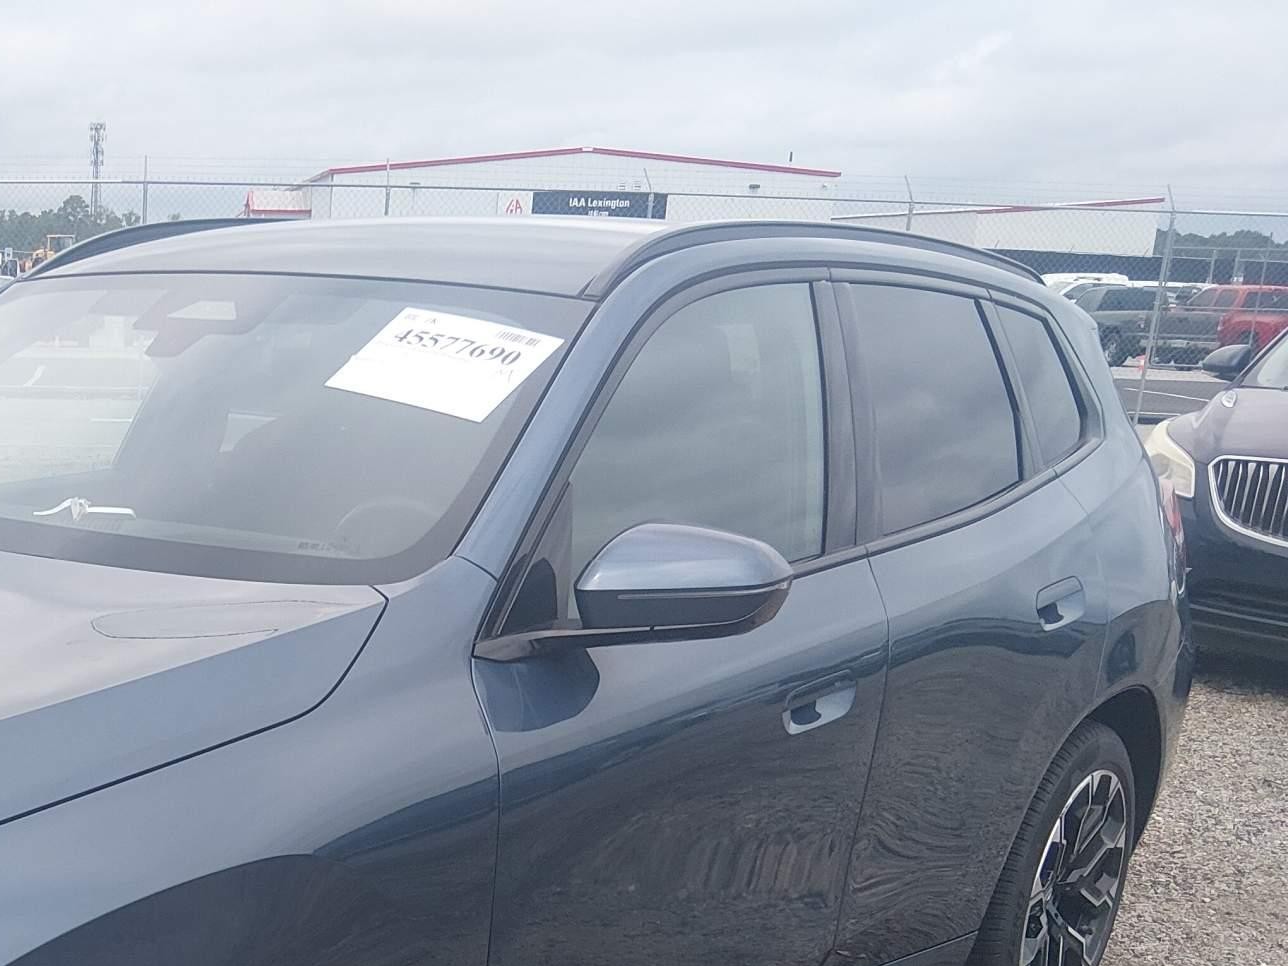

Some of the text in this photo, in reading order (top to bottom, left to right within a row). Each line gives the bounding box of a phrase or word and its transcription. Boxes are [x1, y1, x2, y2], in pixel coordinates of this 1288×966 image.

[569, 197, 631, 209] IAA Lexington
[394, 328, 522, 366] 45577690
